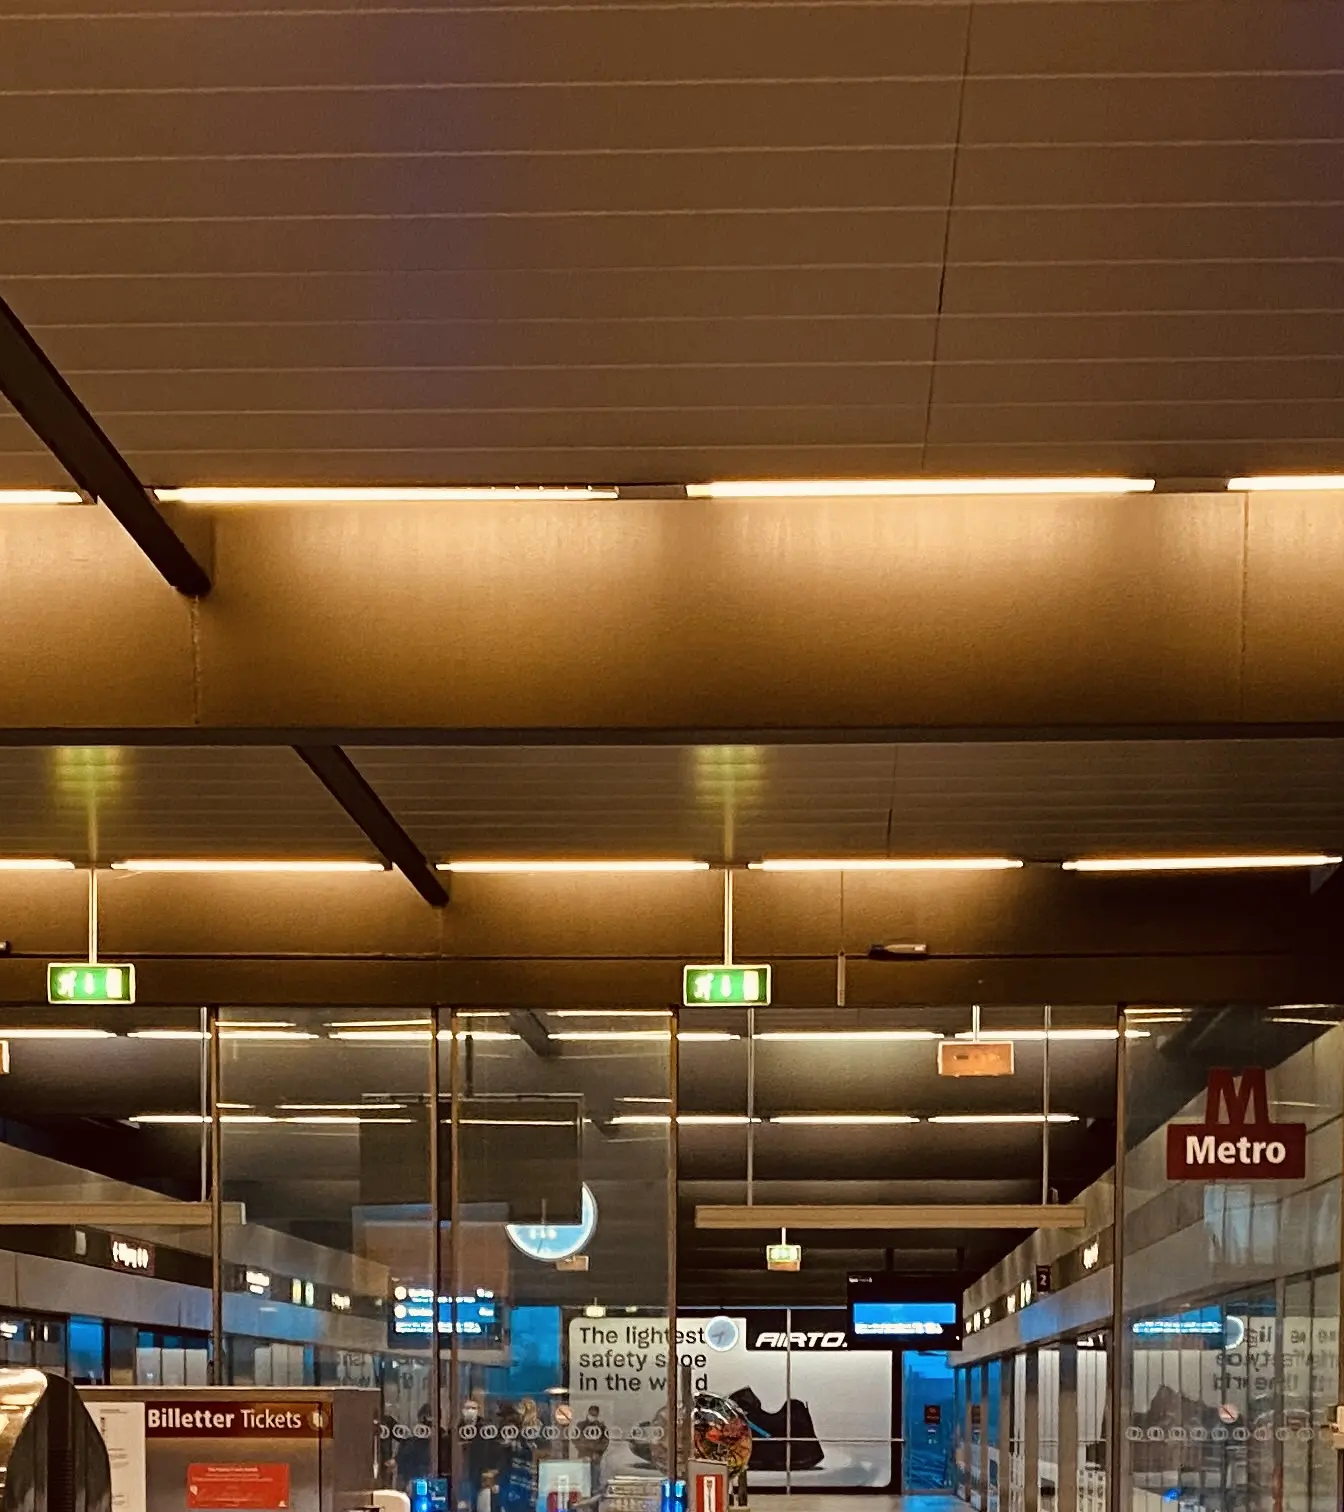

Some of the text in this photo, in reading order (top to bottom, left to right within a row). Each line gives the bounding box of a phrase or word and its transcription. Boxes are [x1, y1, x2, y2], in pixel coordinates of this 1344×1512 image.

[1185, 1135, 1286, 1165] Metro
[579, 1327, 618, 1345] The
[579, 1350, 707, 1372] safety soe
[579, 1372, 598, 1392] in
[605, 1373, 641, 1391] the
[147, 1408, 302, 1429] Billetter Tickets
